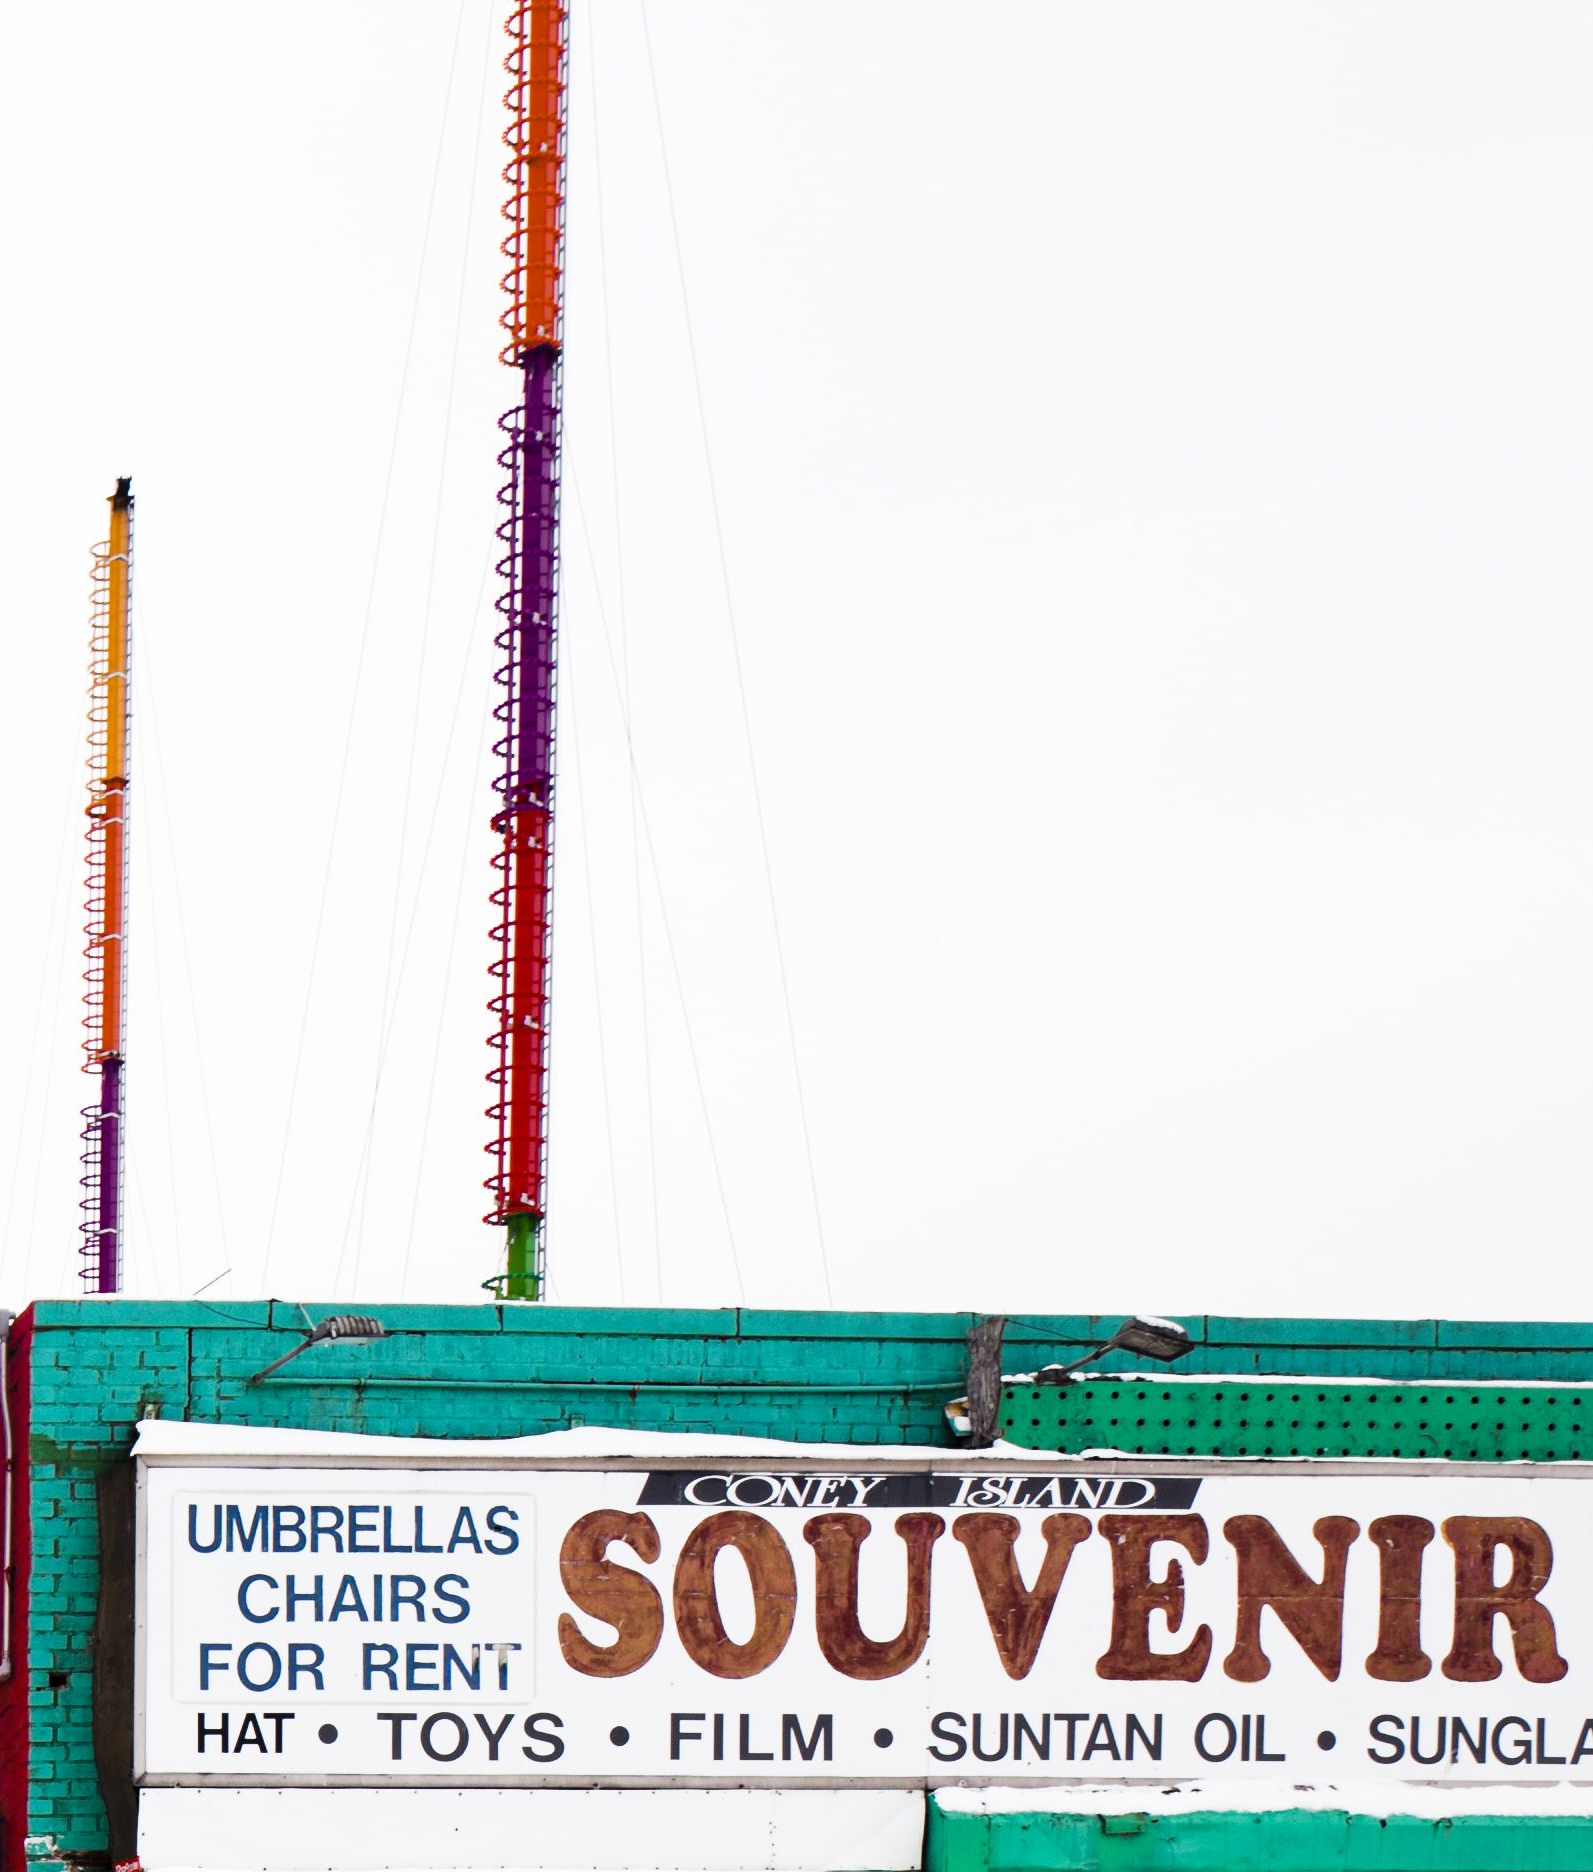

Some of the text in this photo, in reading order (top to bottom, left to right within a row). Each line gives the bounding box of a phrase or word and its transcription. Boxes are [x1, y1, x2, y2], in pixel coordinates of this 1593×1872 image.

[684, 1475, 1156, 1508] CONEY ISLAND
[188, 1504, 519, 1555] UMBRELLAS
[238, 1573, 471, 1623] CHAIRS
[558, 1509, 1569, 1684] SOUVENIR
[200, 1642, 521, 1692] FOR RENT
[198, 1713, 295, 1754] HAT
[377, 1712, 565, 1762] TOYS
[671, 1713, 833, 1761] FILM
[929, 1712, 1162, 1762] SUNTAN
[1195, 1713, 1286, 1762] OIL
